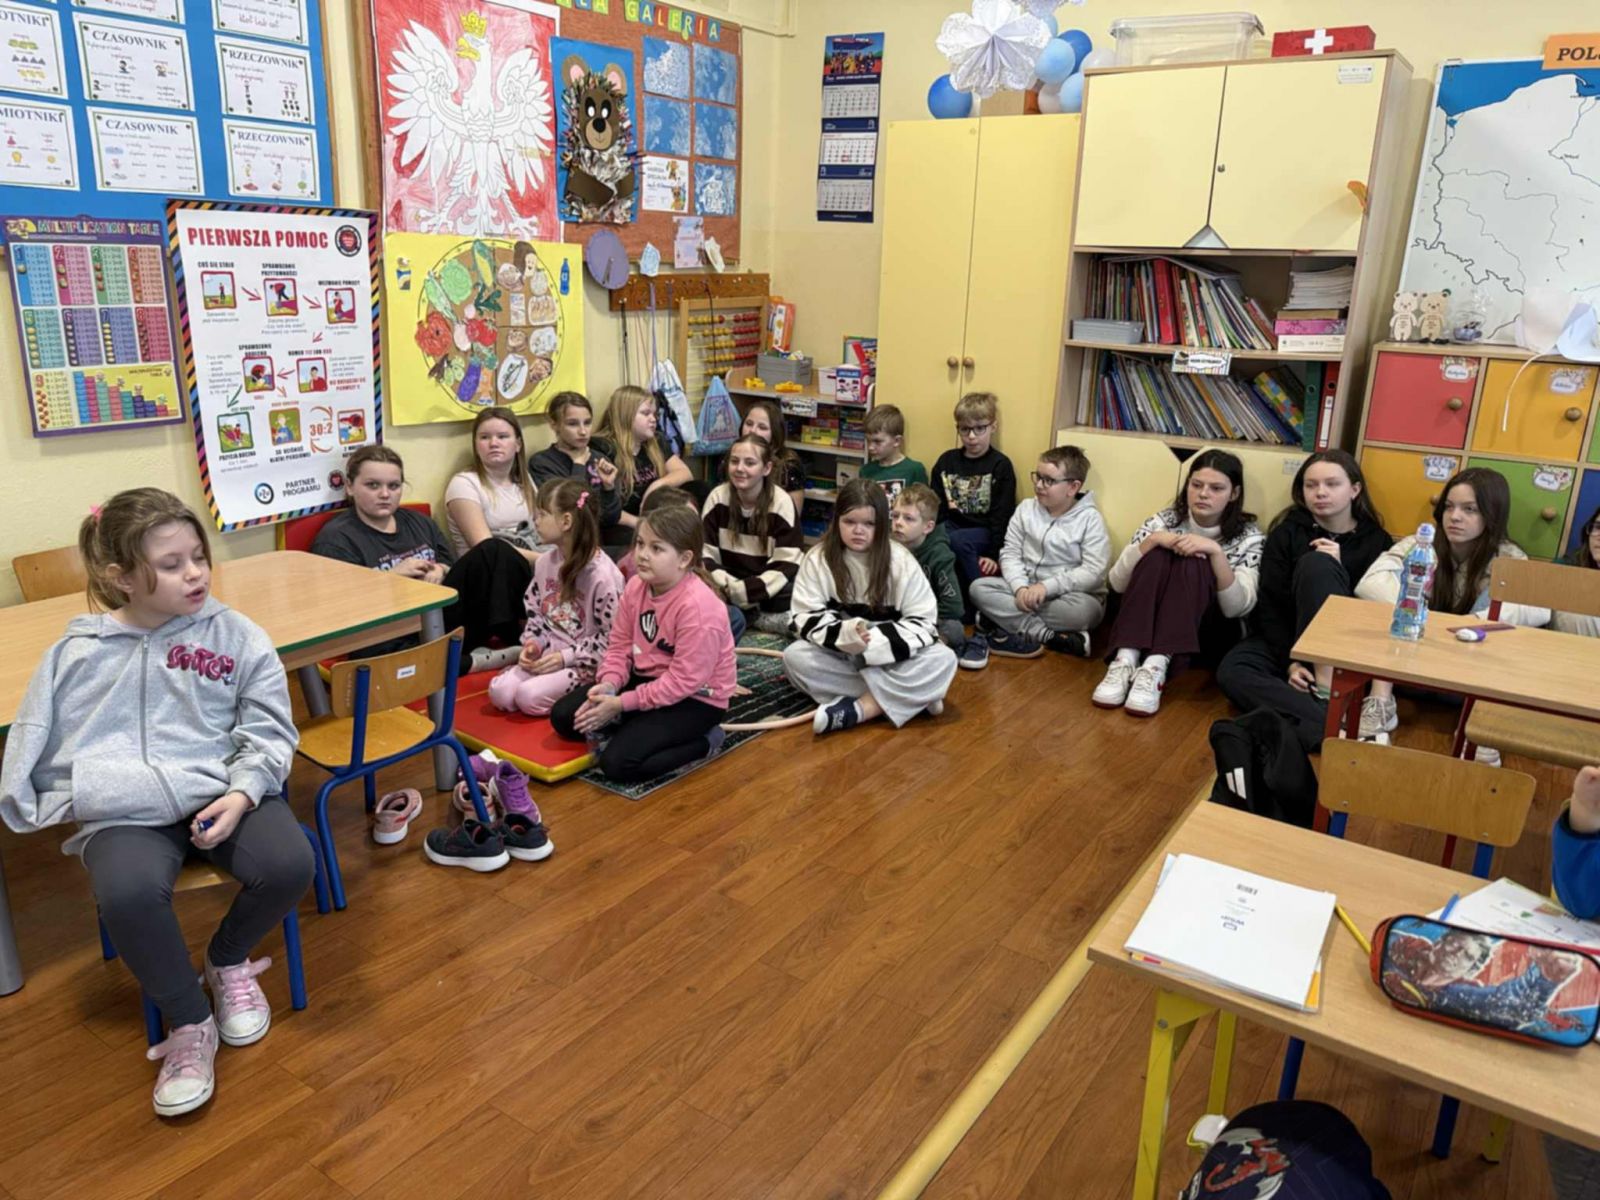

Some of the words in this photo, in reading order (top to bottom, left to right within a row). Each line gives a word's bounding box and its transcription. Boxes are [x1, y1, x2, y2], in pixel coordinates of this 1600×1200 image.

[626, 1, 719, 39] GALERIA
[92, 30, 167, 50] CZASOWNIK
[229, 50, 299, 69] RZECZOWNIK
[1556, 46, 1600, 61] POL
[105, 119, 178, 135] CZASOWNIK
[237, 131, 306, 146] RZECZOWNIK
[187, 227, 272, 247] PIERWSZA
[275, 230, 329, 249] POMOC
[310, 422, 333, 437] 30:2
[282, 484, 321, 498] PROGRAMU
[285, 478, 316, 489] PARTNER
